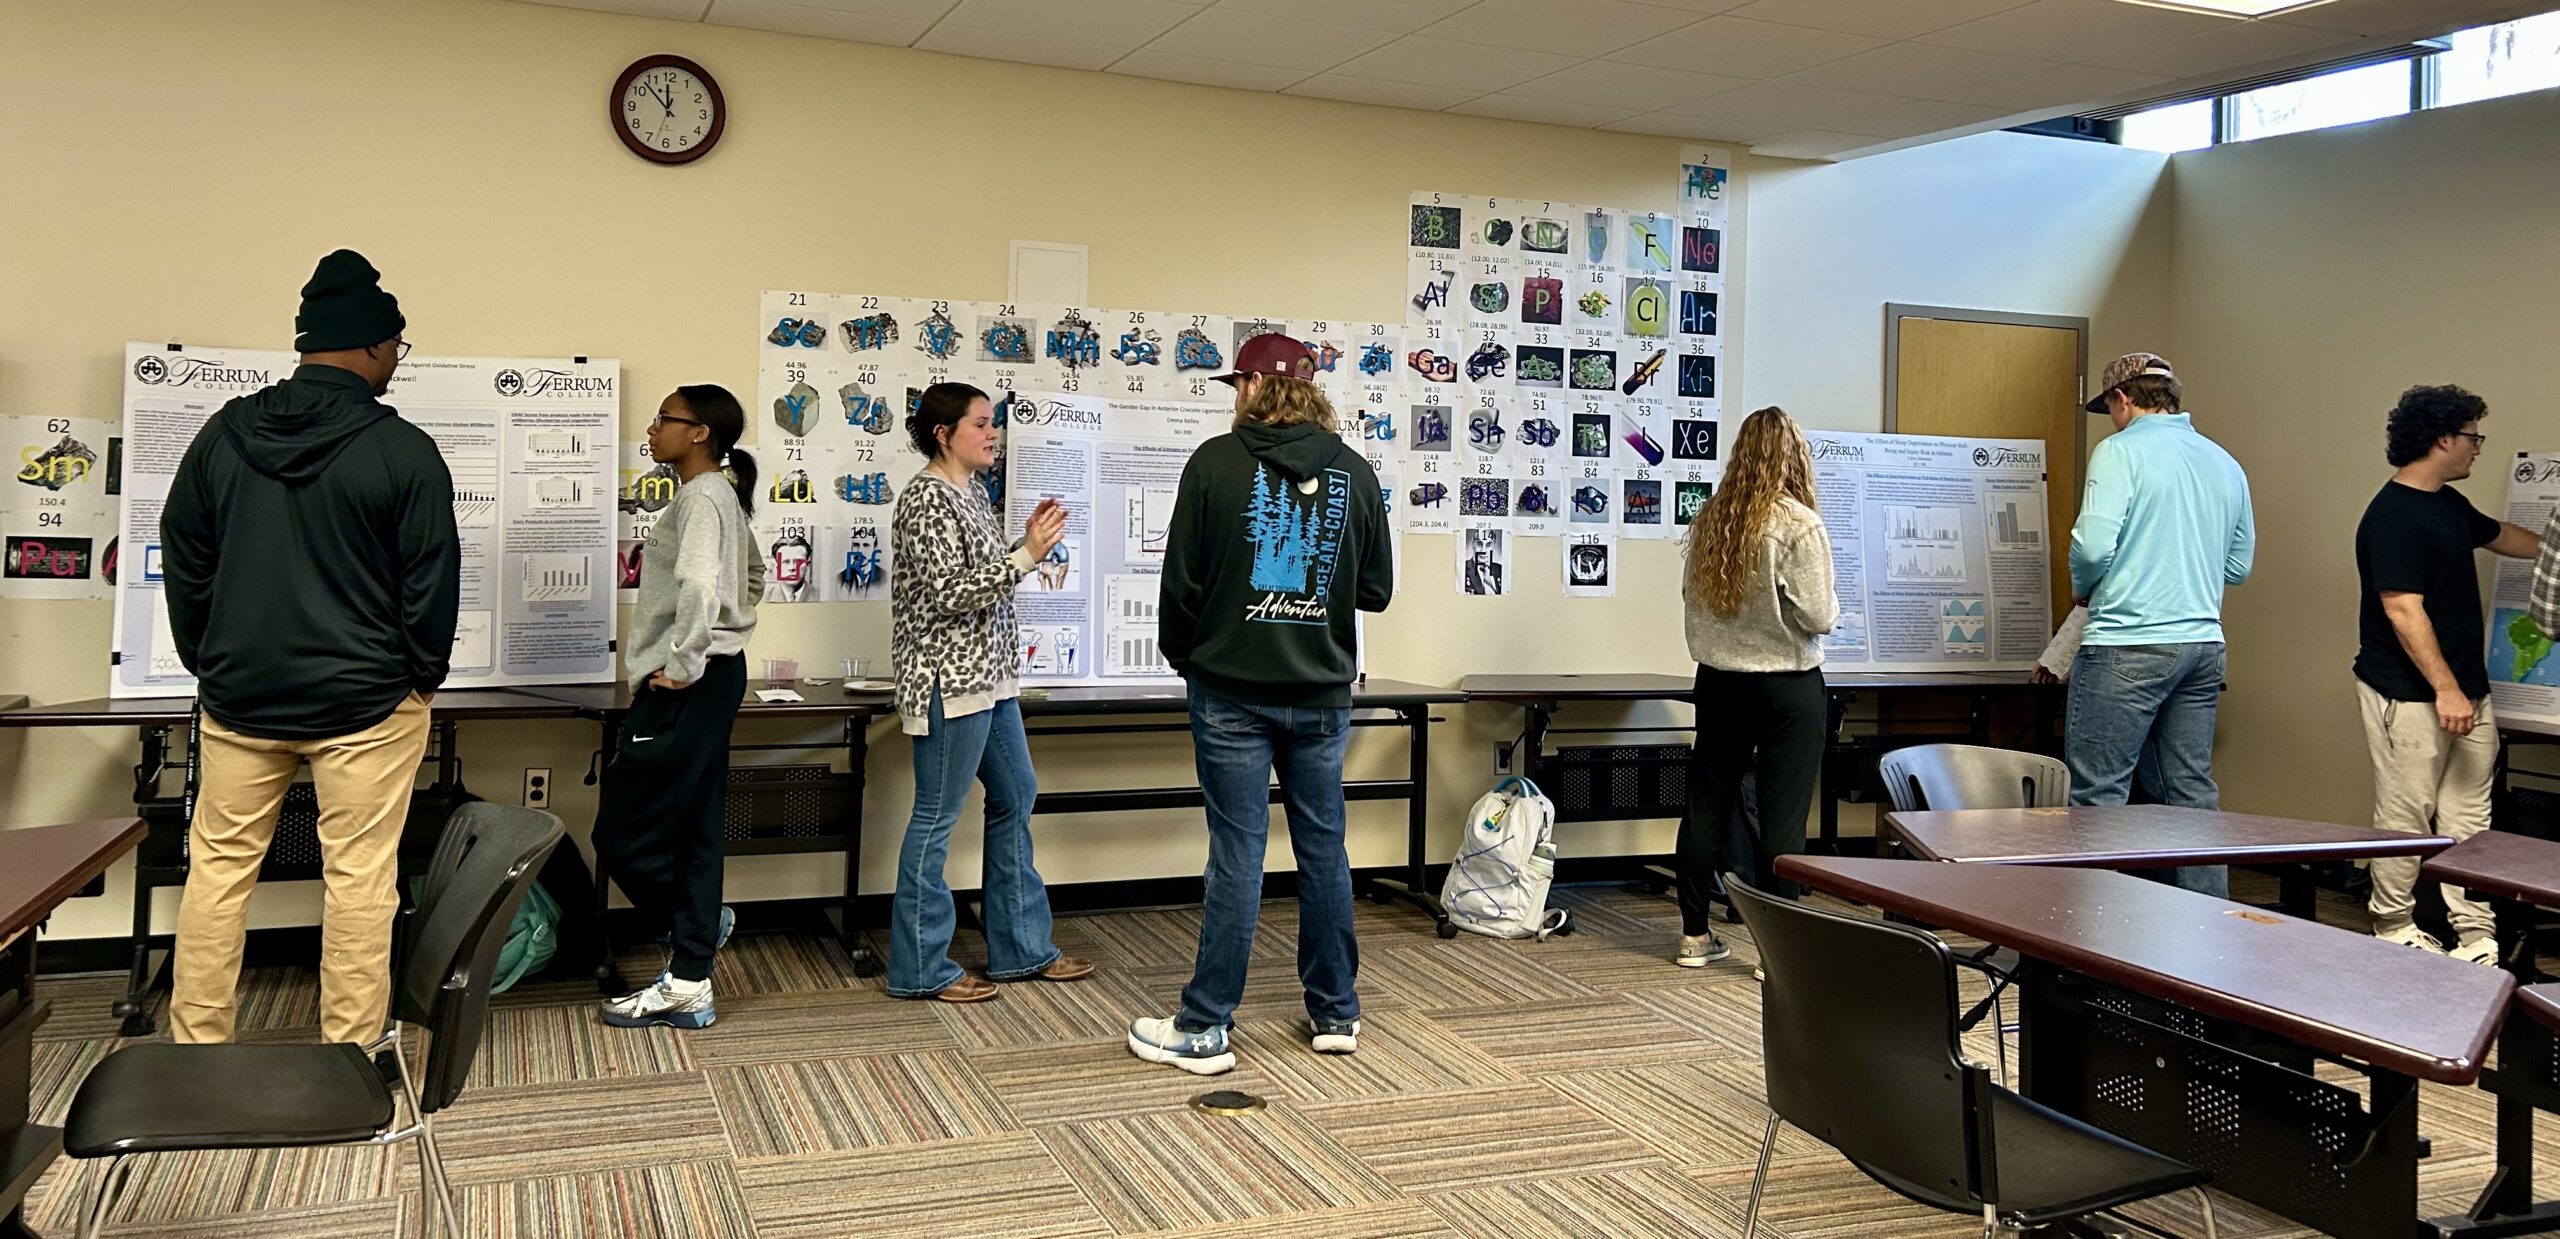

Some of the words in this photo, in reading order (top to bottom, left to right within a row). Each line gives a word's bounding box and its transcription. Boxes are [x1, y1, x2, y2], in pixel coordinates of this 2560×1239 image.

[647, 74, 658, 85] 11
[663, 72, 677, 83] 12
[684, 79, 689, 89] 1
[633, 86, 646, 97] 10
[694, 93, 702, 103] 2
[628, 101, 636, 111] 9
[699, 109, 707, 120] 3
[632, 118, 640, 129] 8
[693, 126, 701, 135] 4
[645, 132, 654, 142] 7
[679, 136, 687, 146] 5
[662, 138, 670, 149] 6
[1702, 154, 1708, 165] 2
[1688, 174, 1720, 200] He
[1434, 193, 1440, 204] 5
[1490, 198, 1496, 208] 6
[1544, 203, 1549, 212] 7
[1596, 208, 1602, 218] 8
[1648, 213, 1654, 223] 9
[1696, 218, 1708, 228] 10
[1428, 214, 1445, 241] B
[1484, 218, 1500, 244] C
[1536, 222, 1552, 248] N
[1644, 234, 1656, 257] F
[1685, 230, 1716, 266] Ne
[1430, 260, 1442, 270] 13
[1484, 264, 1497, 274] 14
[1538, 268, 1550, 278] 15
[1592, 272, 1603, 283] 16
[1644, 278, 1655, 288] 17
[1694, 282, 1706, 292] 18
[789, 293, 806, 306] 21
[1423, 280, 1446, 307] Al
[861, 297, 878, 309] 22
[932, 301, 948, 313] 23
[1536, 290, 1550, 314] P
[1000, 305, 1016, 316] 24
[1065, 308, 1080, 320] 25
[1637, 297, 1658, 322] Cl
[1682, 292, 1716, 332] Ar
[1129, 312, 1144, 324] 26
[1192, 316, 1206, 326] 27
[1253, 319, 1267, 330] 28
[1312, 322, 1326, 332] 29
[1370, 325, 1384, 335] 30
[853, 319, 882, 350] Ti
[926, 324, 953, 353] V
[1428, 328, 1440, 338] 31
[1482, 331, 1495, 341] 32
[1534, 334, 1548, 344] 33
[988, 326, 1025, 357] Cr
[1046, 330, 1099, 360] Mn
[1588, 337, 1600, 348] 34
[1640, 342, 1653, 351] 35
[1121, 334, 1155, 362] Fe
[1180, 337, 1218, 366] Co
[1692, 344, 1704, 354] 36
[1359, 346, 1392, 372] Zn
[1416, 348, 1450, 375] Ga
[1470, 352, 1505, 378] Ge
[167, 356, 270, 387] FERRUM
[858, 364, 878, 372] 47.87
[1526, 354, 1555, 382] As
[1634, 362, 1660, 386] Br
[787, 370, 805, 382] 39
[858, 372, 876, 385] 40
[1682, 357, 1712, 392] Kr
[194, 382, 260, 391] COLLEG
[524, 368, 612, 397] FERRUM
[996, 378, 1012, 390] 42
[1063, 380, 1078, 391] 43
[1128, 382, 1144, 393] 44
[1191, 385, 1206, 396] 45
[1369, 393, 1382, 403] 48
[1426, 395, 1439, 406] 49
[1481, 398, 1494, 408] 50
[785, 395, 806, 425] Y
[1533, 400, 1546, 410] 51
[1586, 403, 1599, 414] 52
[1638, 406, 1651, 416] 53
[848, 397, 885, 426] Zr
[1036, 399, 1102, 426] FERRUM
[1690, 408, 1702, 418] 54
[47, 419, 70, 434] 62
[1054, 421, 1101, 430] COLLEGE
[1470, 418, 1500, 444] Sn
[1522, 418, 1554, 446] Sb
[1577, 423, 1605, 450] Te
[1680, 423, 1709, 455] Xe
[786, 448, 803, 460] 71
[1812, 438, 1864, 460] FERRUM
[857, 450, 874, 462] 72
[1990, 446, 2040, 467] FERRUM
[17, 446, 91, 483] Sm
[1424, 462, 1437, 472] 81
[1479, 464, 1492, 474] 82
[1531, 466, 1544, 476] 83
[1584, 468, 1597, 478] 84
[1637, 470, 1650, 480] 85
[1688, 472, 1700, 482] 86
[618, 469, 675, 500] Tm
[774, 472, 812, 503] Lu
[846, 472, 886, 503] Hf
[38, 498, 66, 506] 150.4
[1324, 475, 1346, 530] COAST
[1468, 484, 1500, 510] Pb
[1576, 488, 1604, 513] Po
[38, 513, 63, 527] 94
[780, 527, 805, 539] 103
[850, 527, 876, 539] 104
[1474, 530, 1494, 541] 114
[1581, 534, 1599, 544] 116
[20, 542, 78, 576] Pu
[1475, 550, 1493, 576] Fl
[846, 550, 882, 582] Rf
[1316, 540, 1336, 596] OCEAN
[1246, 592, 1326, 621] Adventur
